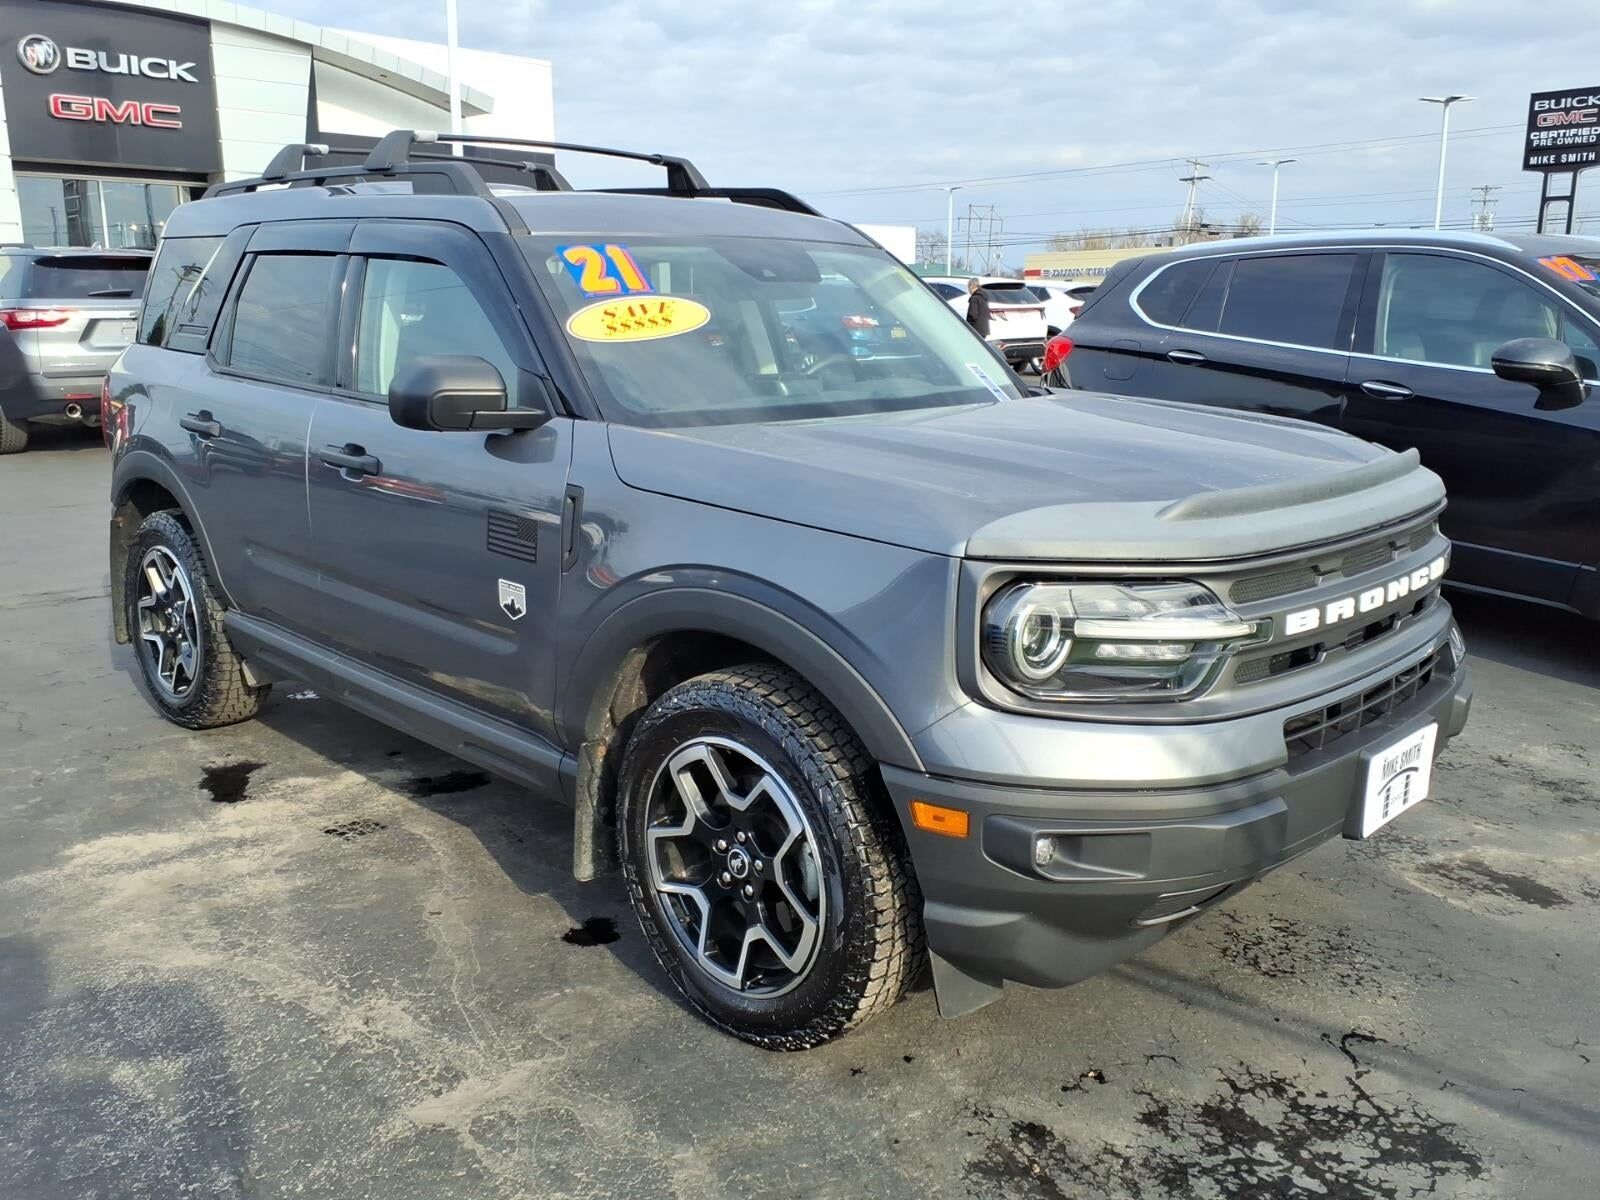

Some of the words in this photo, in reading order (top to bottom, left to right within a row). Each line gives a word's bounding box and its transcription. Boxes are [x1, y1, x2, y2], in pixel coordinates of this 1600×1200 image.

[66, 47, 198, 82] BUICK
[50, 93, 182, 128] GMC
[1534, 96, 1600, 110] BUICK
[1537, 108, 1598, 127] GMC
[1530, 126, 1600, 140] CERTIFIED
[1533, 135, 1597, 146] PRE-OWNED
[1529, 155, 1556, 165] MIKE
[1561, 152, 1595, 163] SMITH
[563, 244, 653, 293] 21
[1051, 268, 1084, 278] DUNN
[1285, 557, 1446, 636] BRONCO
[1382, 756, 1399, 779] MIKE
[1400, 743, 1422, 769] SMITH
